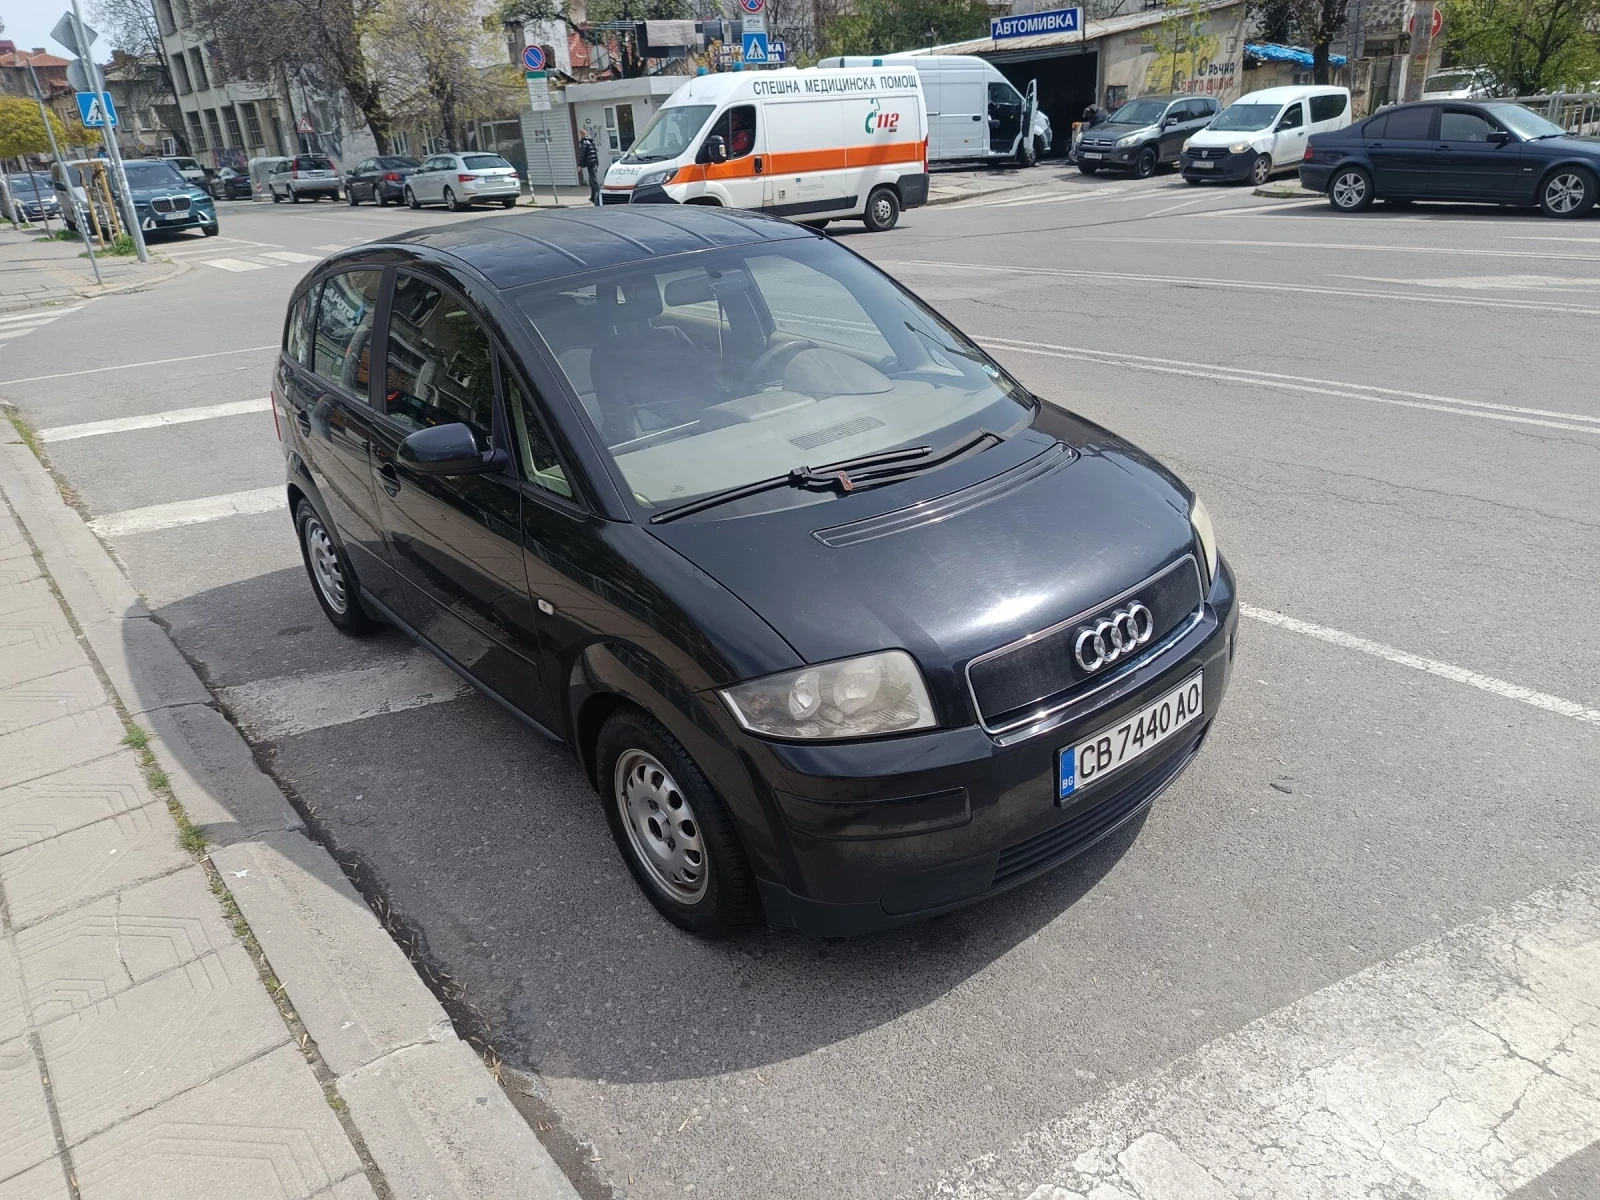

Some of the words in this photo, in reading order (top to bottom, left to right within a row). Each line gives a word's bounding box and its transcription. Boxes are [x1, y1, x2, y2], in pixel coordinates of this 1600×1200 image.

[995, 13, 1074, 36] АВТОМИВКА
[753, 80, 800, 95] СПЕШНА
[805, 76, 877, 93] МЕДИЦИНСКА
[880, 75, 918, 89] ПОМОЩ
[877, 113, 900, 128] 112
[1079, 736, 1112, 779] CB
[1117, 701, 1171, 761] 7440
[1174, 682, 1200, 727] AO
[1062, 775, 1074, 790] BG
